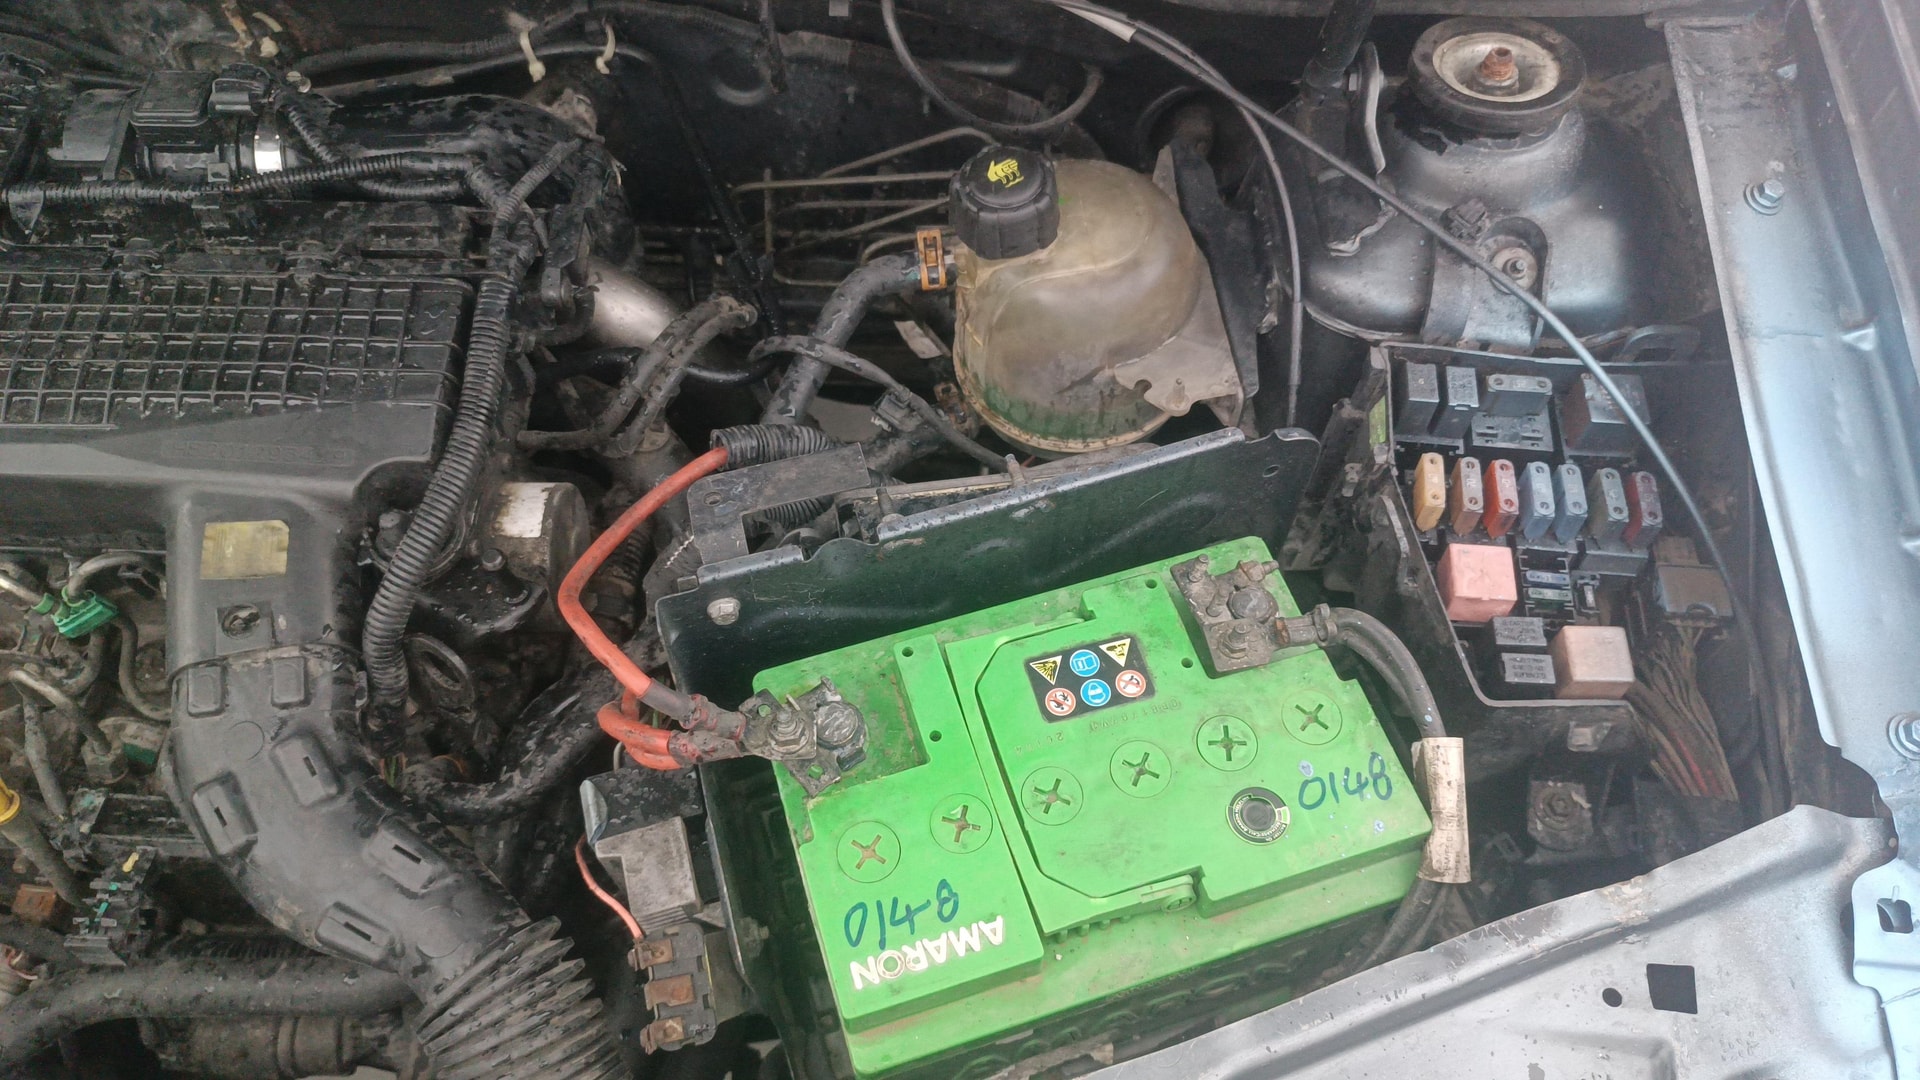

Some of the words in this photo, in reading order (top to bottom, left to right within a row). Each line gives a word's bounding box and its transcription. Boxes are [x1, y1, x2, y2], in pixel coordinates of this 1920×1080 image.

[1298, 751, 1393, 810] 0148
[844, 879, 959, 950] 0148
[850, 915, 1004, 990] AMARON
